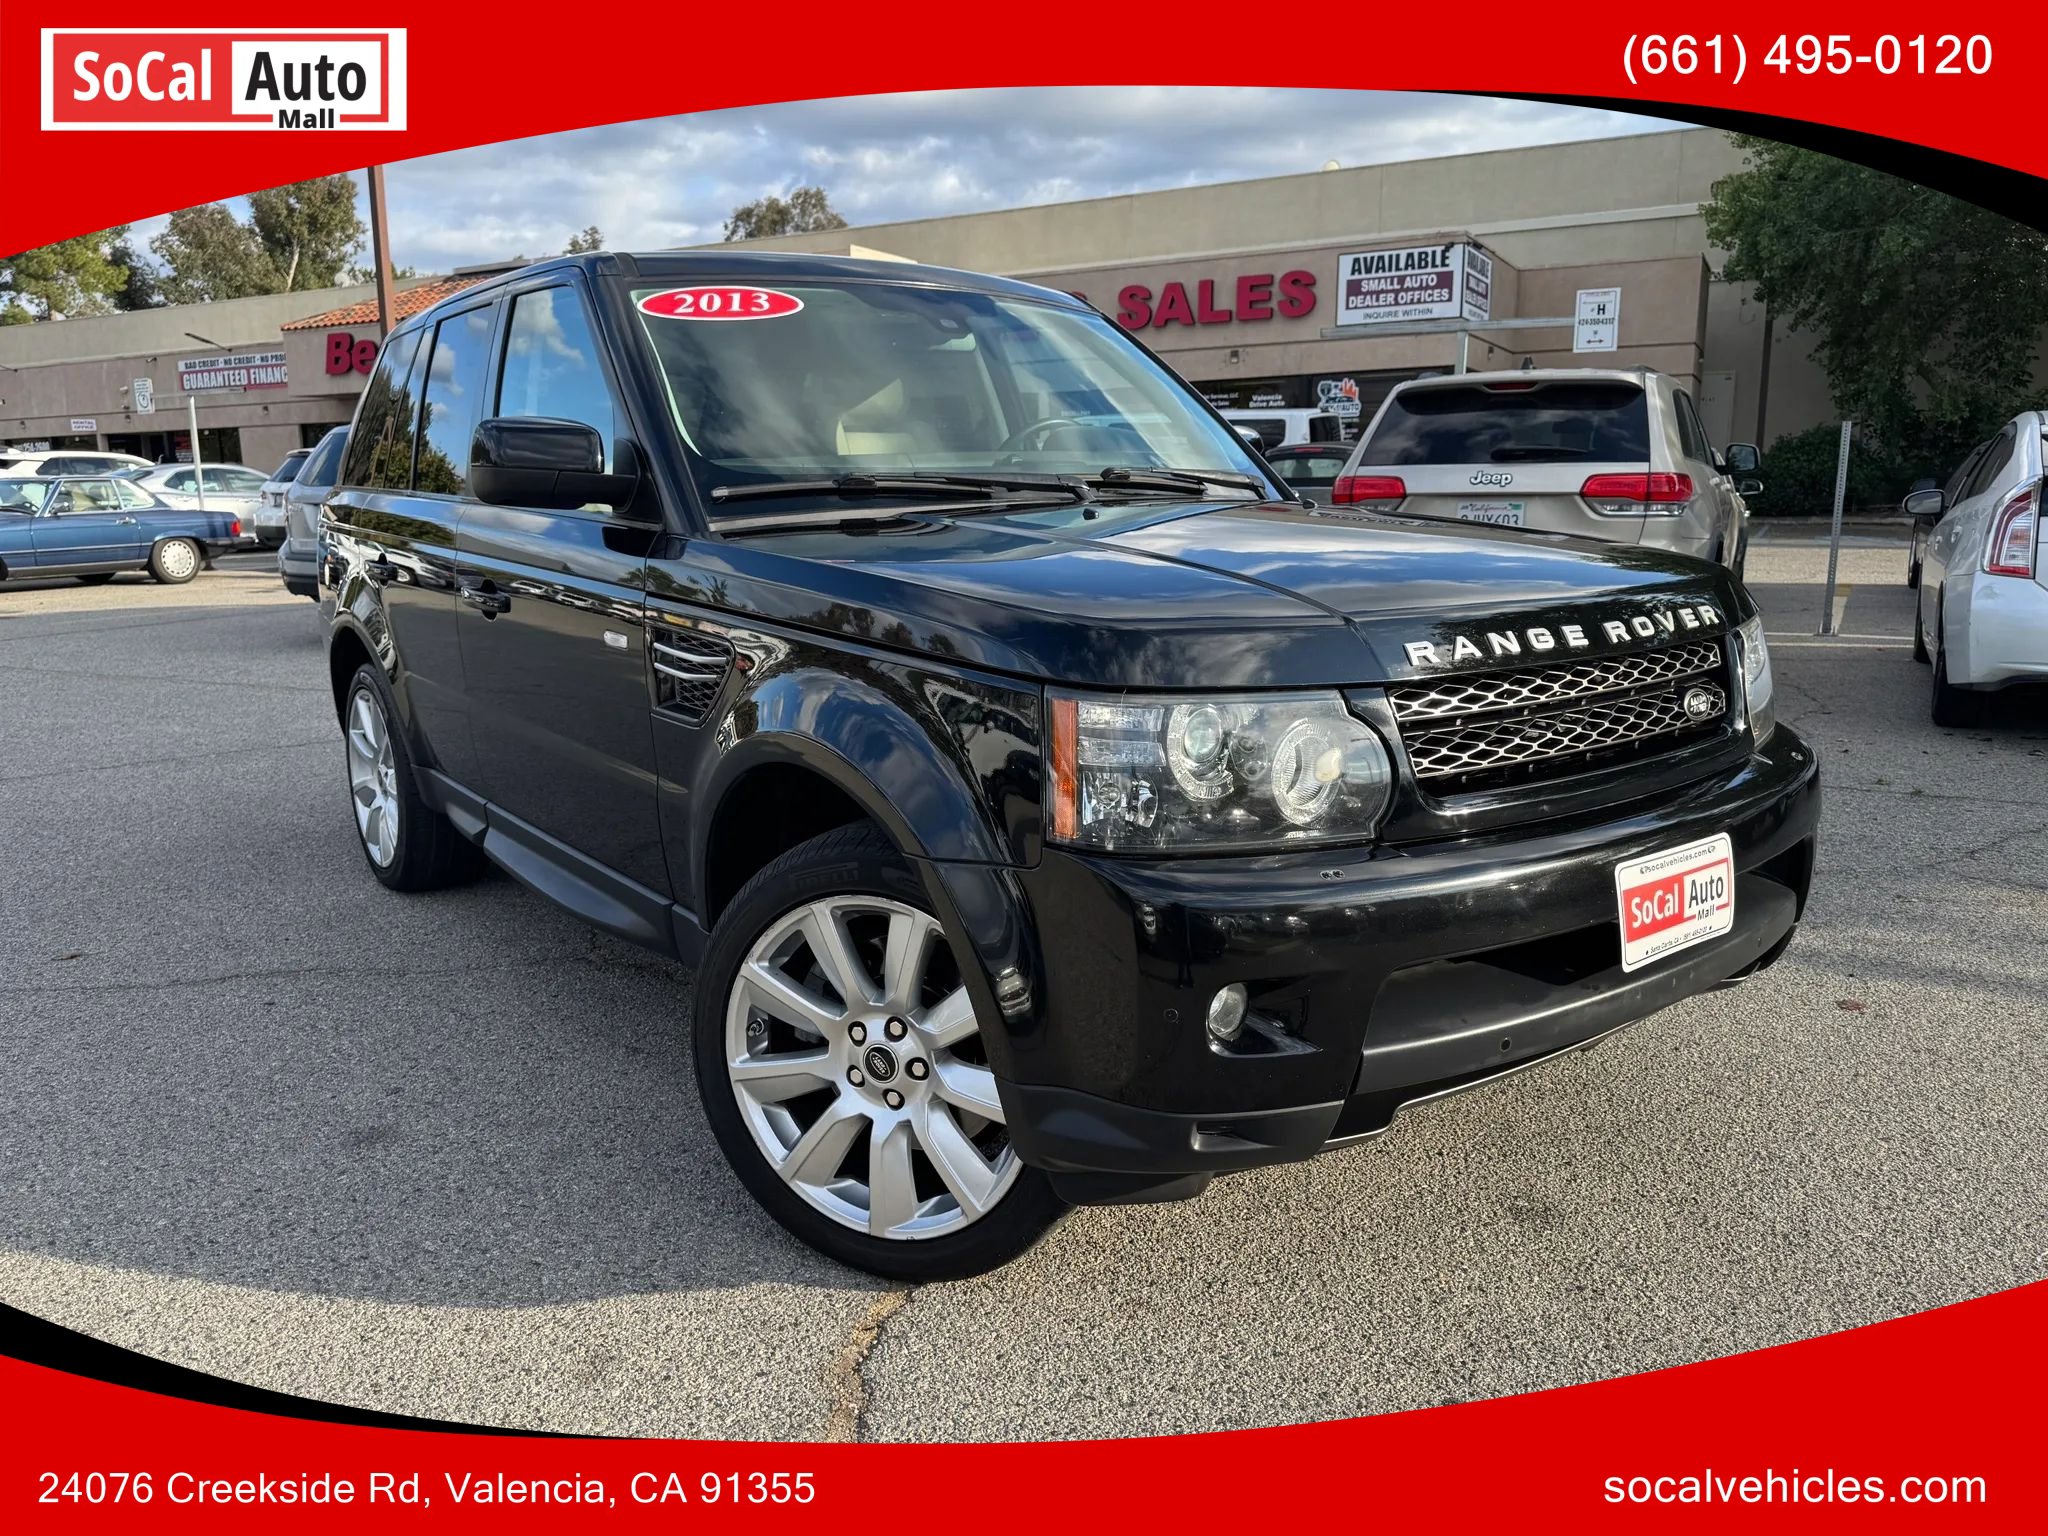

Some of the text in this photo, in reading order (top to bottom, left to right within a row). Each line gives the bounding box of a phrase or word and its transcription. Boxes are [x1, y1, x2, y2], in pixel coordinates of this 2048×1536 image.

[1350, 249, 1450, 277] AVAILABLE
[1361, 274, 1437, 292] SMALL AUTO
[673, 292, 771, 314] 2013
[1117, 270, 1317, 331] SALES
[1349, 293, 1395, 308] DEALER
[1398, 288, 1449, 304] OFFICES
[1363, 308, 1433, 321] INQUIRE WITHIN
[1597, 303, 1606, 316] H
[184, 362, 197, 370] BAD
[198, 360, 220, 369] CREDIT
[223, 358, 233, 366] NO
[233, 356, 256, 365] CREDIT
[260, 355, 270, 363] NO
[183, 369, 248, 390] GUARANTEED
[1469, 470, 1513, 487] Jeep
[1403, 604, 1720, 666] RANGE ROVER
[1631, 874, 1724, 929] SoCal Auto
[1697, 904, 1715, 921] Mall
